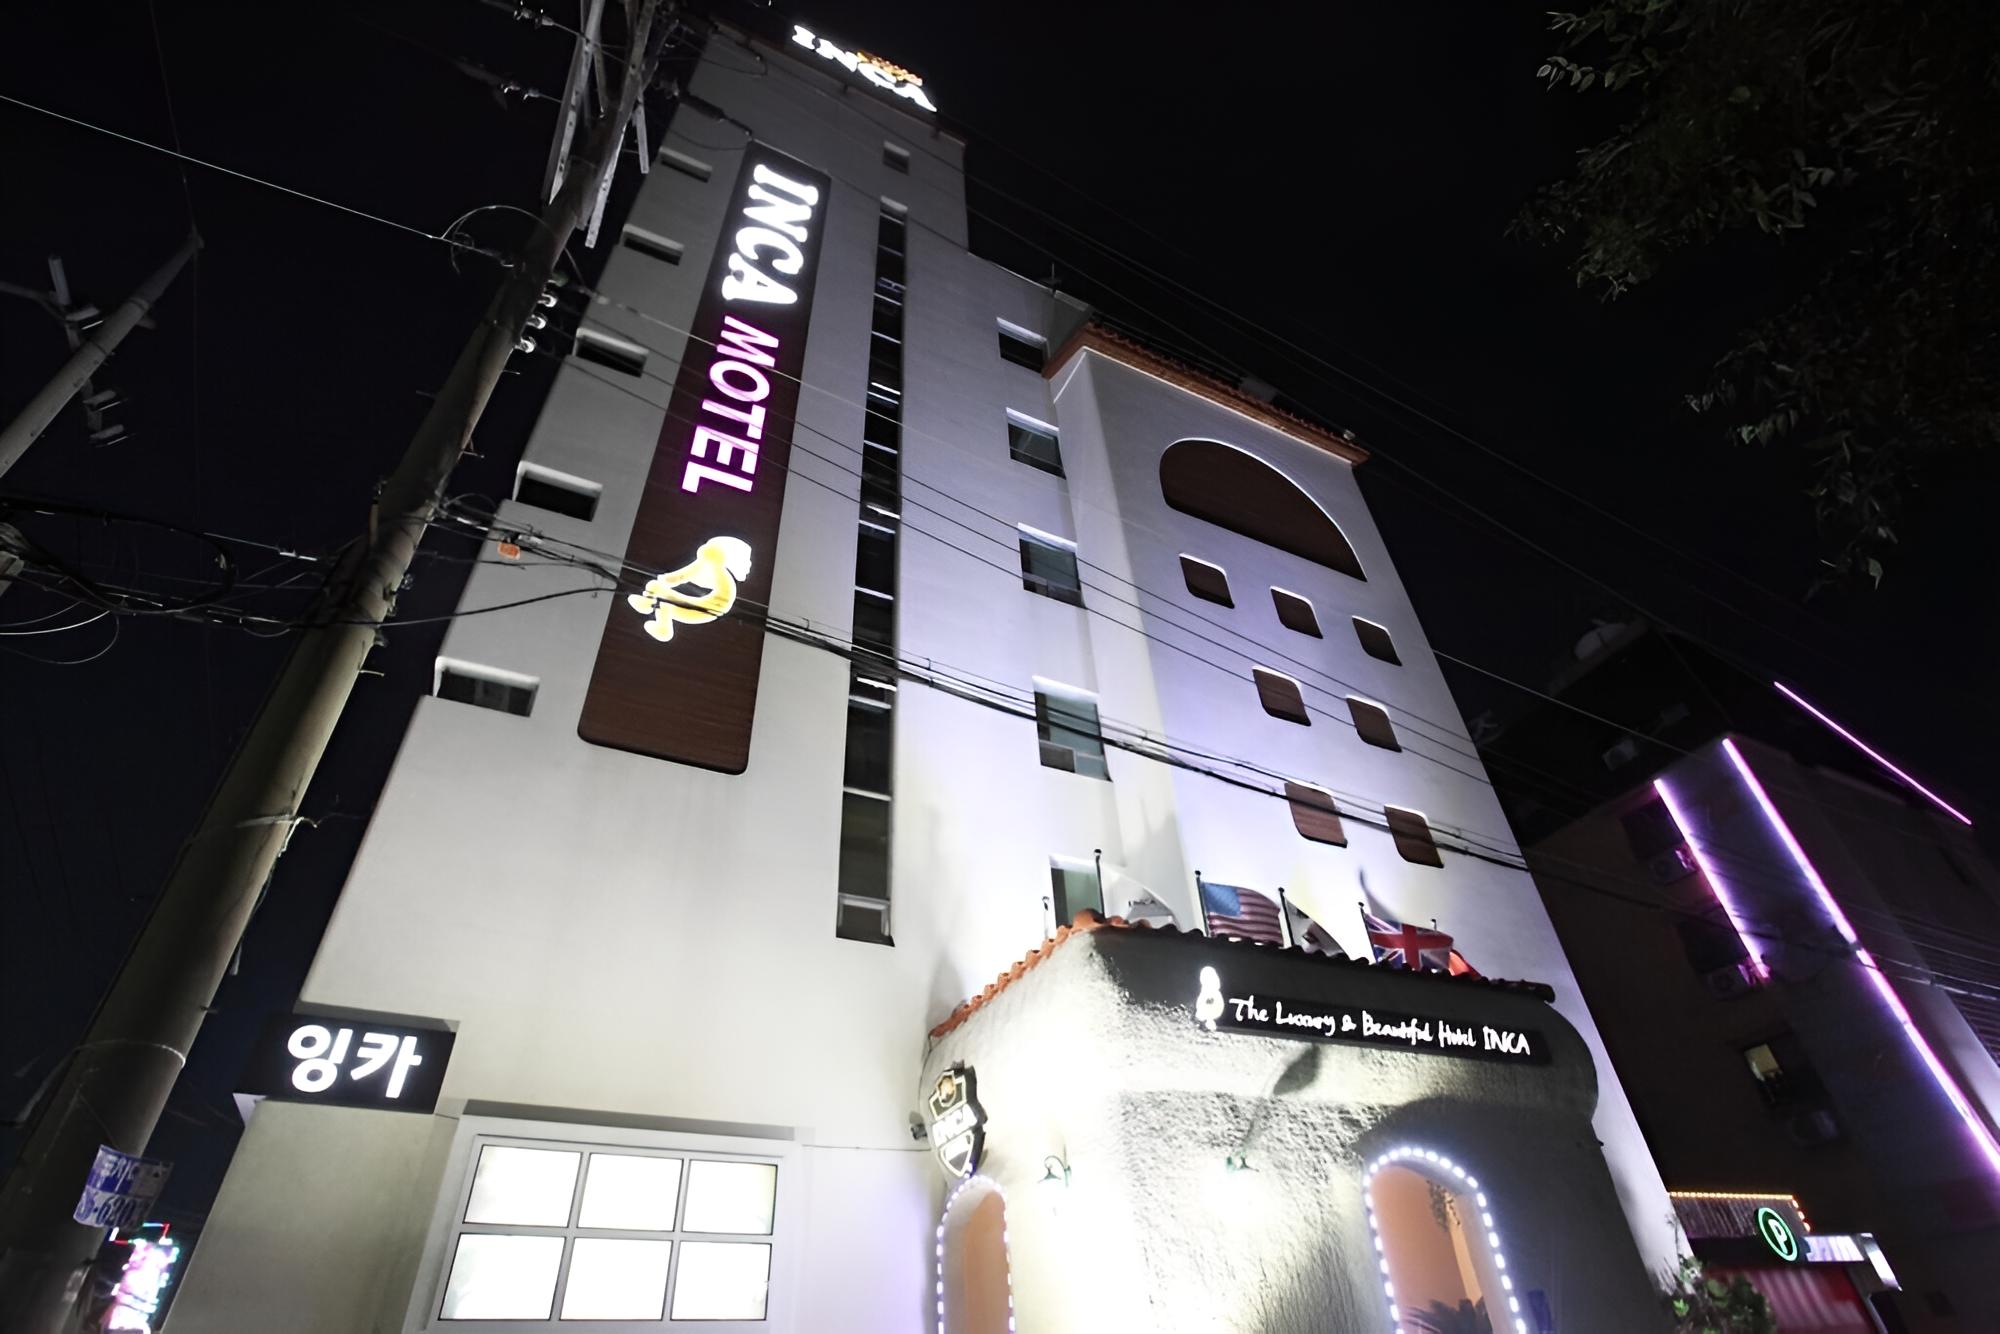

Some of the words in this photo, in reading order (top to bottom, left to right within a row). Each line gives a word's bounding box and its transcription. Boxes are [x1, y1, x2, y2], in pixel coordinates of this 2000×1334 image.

[792, 25, 937, 112] INCA
[721, 164, 819, 305] INCA
[681, 315, 780, 493] MOTEL
[287, 1024, 423, 1099] 잉카
[1229, 995, 1269, 1022] The
[1482, 1025, 1531, 1056] INCA
[1767, 1218, 1788, 1255] P
